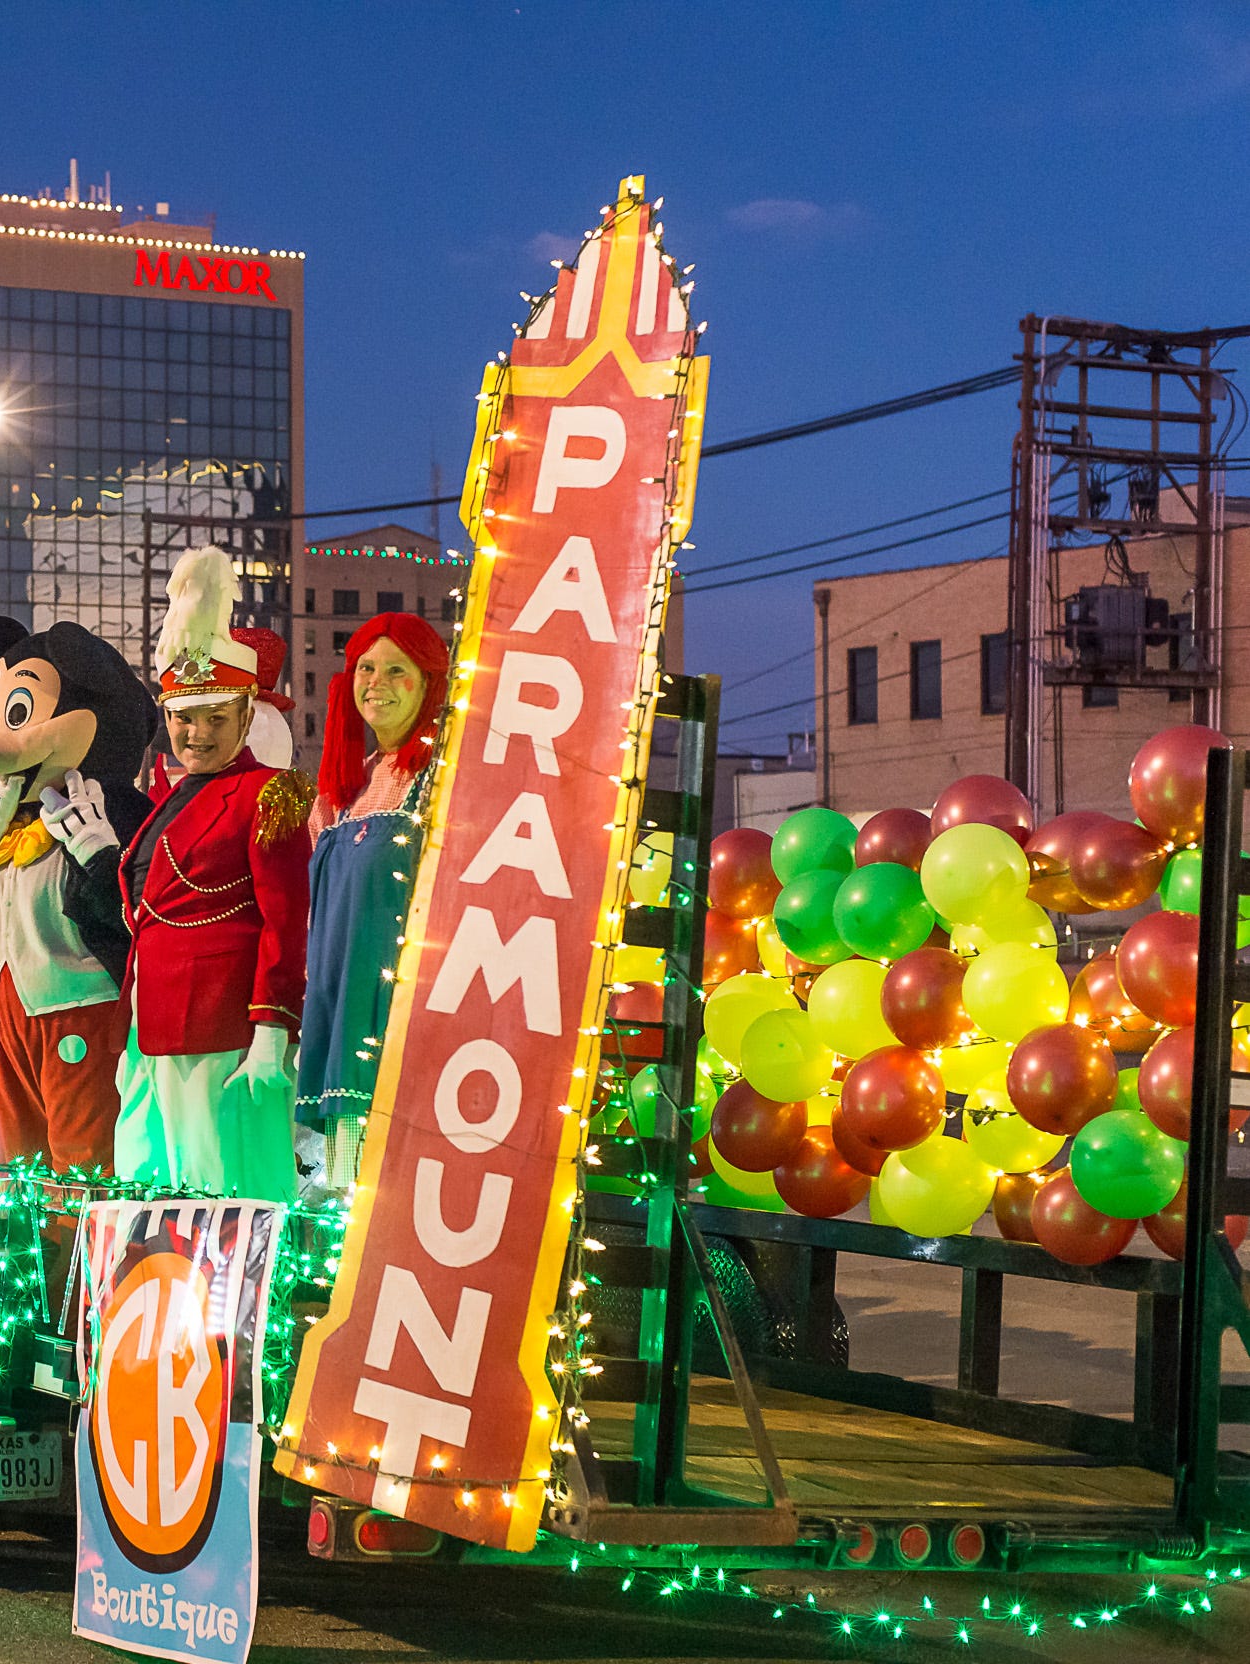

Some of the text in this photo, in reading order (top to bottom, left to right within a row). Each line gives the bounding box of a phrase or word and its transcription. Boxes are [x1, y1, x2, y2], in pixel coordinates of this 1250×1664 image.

[133, 249, 278, 302] MAXOR
[352, 405, 628, 1519] PARAMOUNT
[0, 1458, 55, 1488] 983J
[90, 1568, 239, 1650] Boutique
